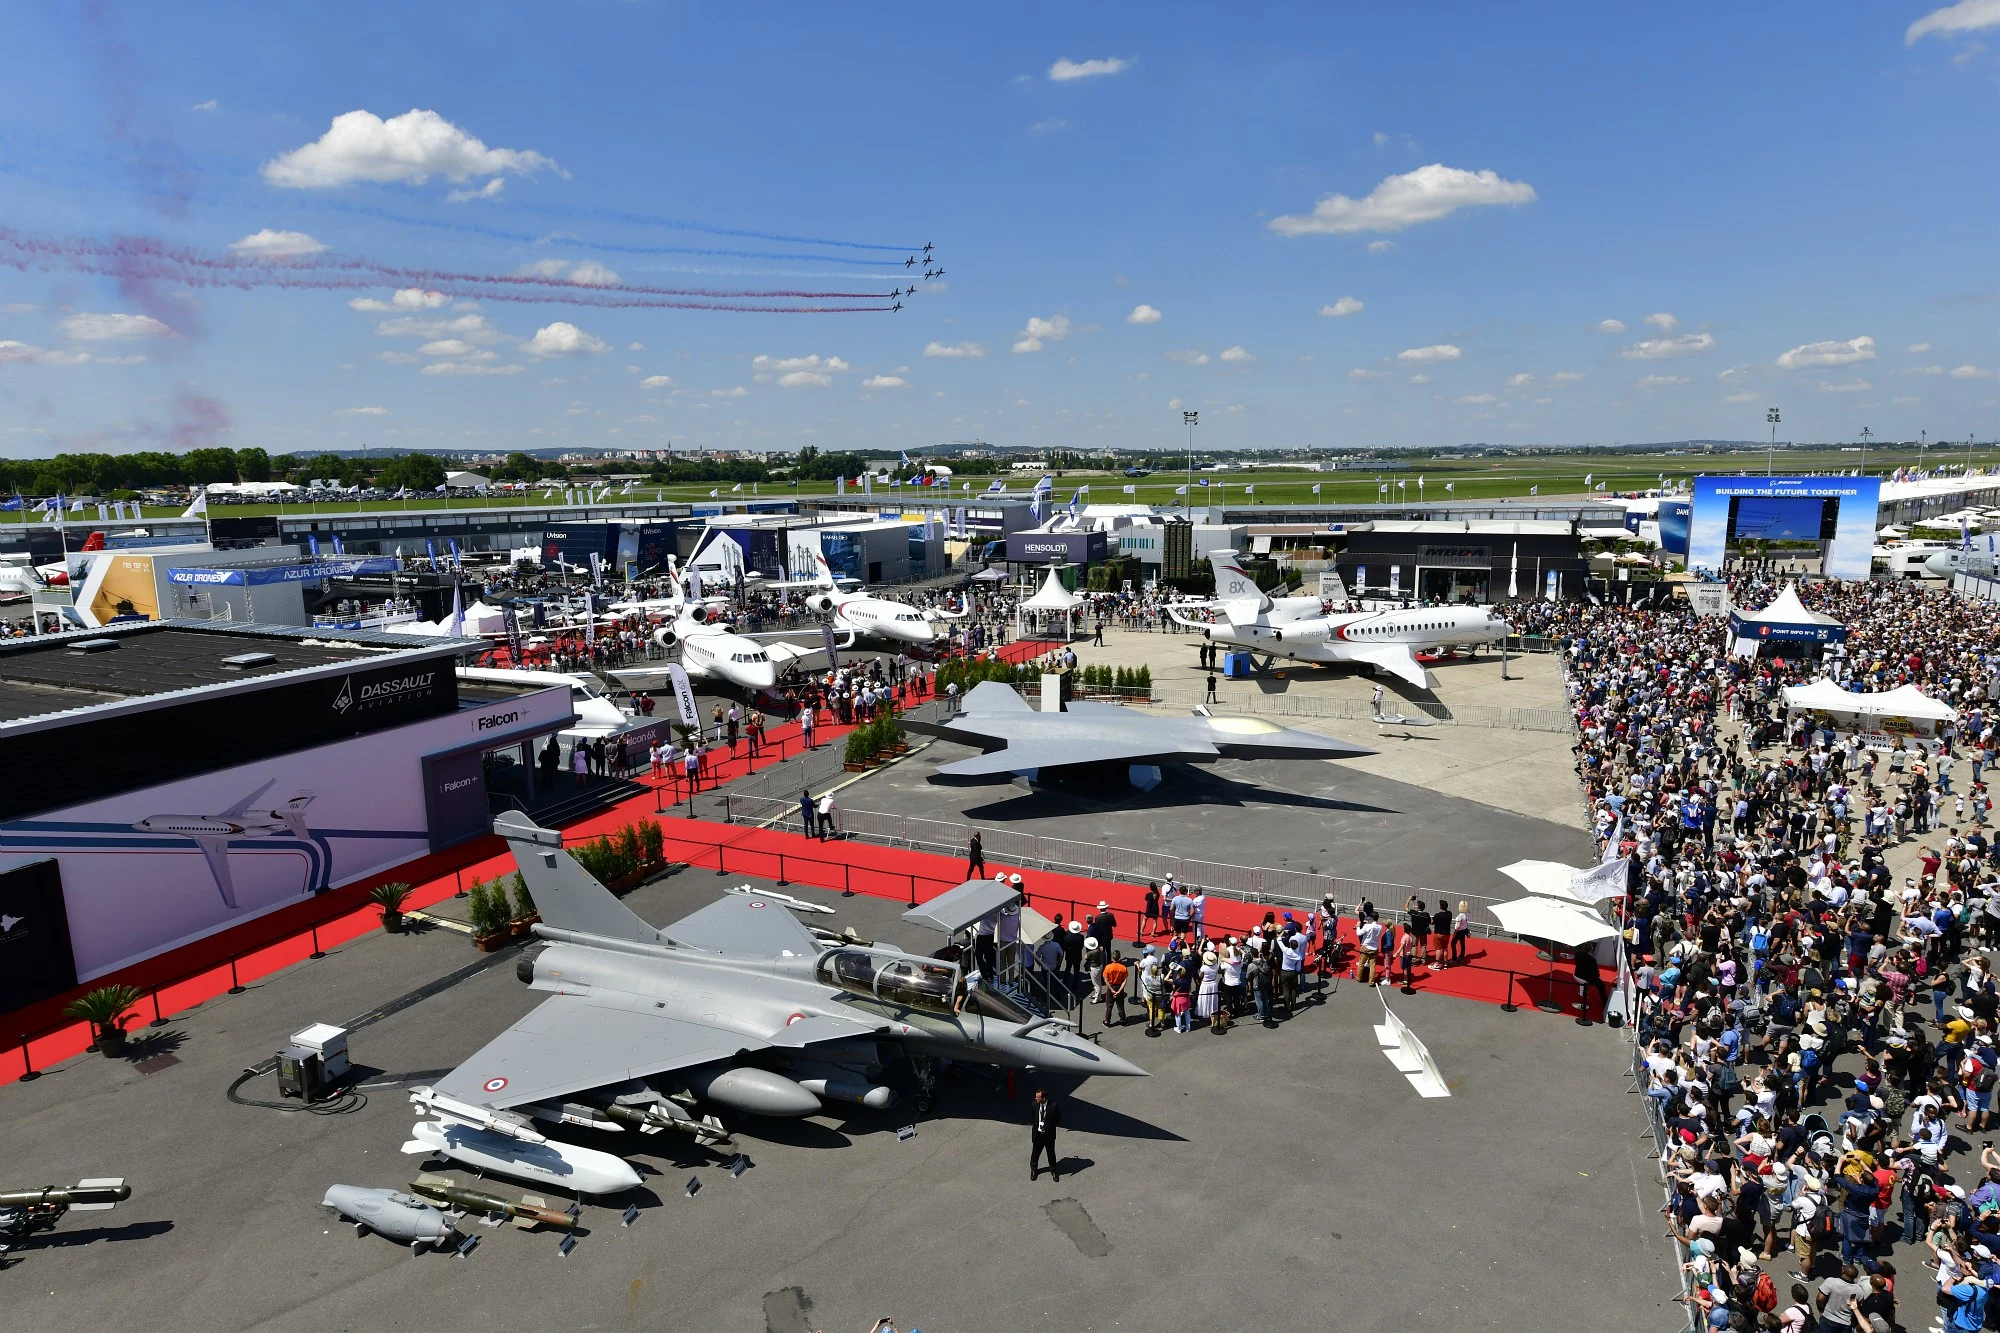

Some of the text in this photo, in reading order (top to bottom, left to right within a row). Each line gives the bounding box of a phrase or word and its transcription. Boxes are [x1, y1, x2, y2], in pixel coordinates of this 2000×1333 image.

[1024, 544, 1065, 552] HENSOLDT
[1424, 548, 1484, 556] MBDA
[173, 573, 222, 582] AZUR DRONES
[283, 564, 351, 580] AZUR DRONES
[1228, 581, 1246, 594] 8X
[360, 672, 435, 699] DASSAULT
[357, 689, 432, 711] AVIATION
[677, 679, 693, 720] Falcon 6X
[478, 710, 519, 731] Falcon
[646, 729, 657, 740] 6X
[444, 777, 471, 793] Falcon
[289, 802, 300, 810] 8X
